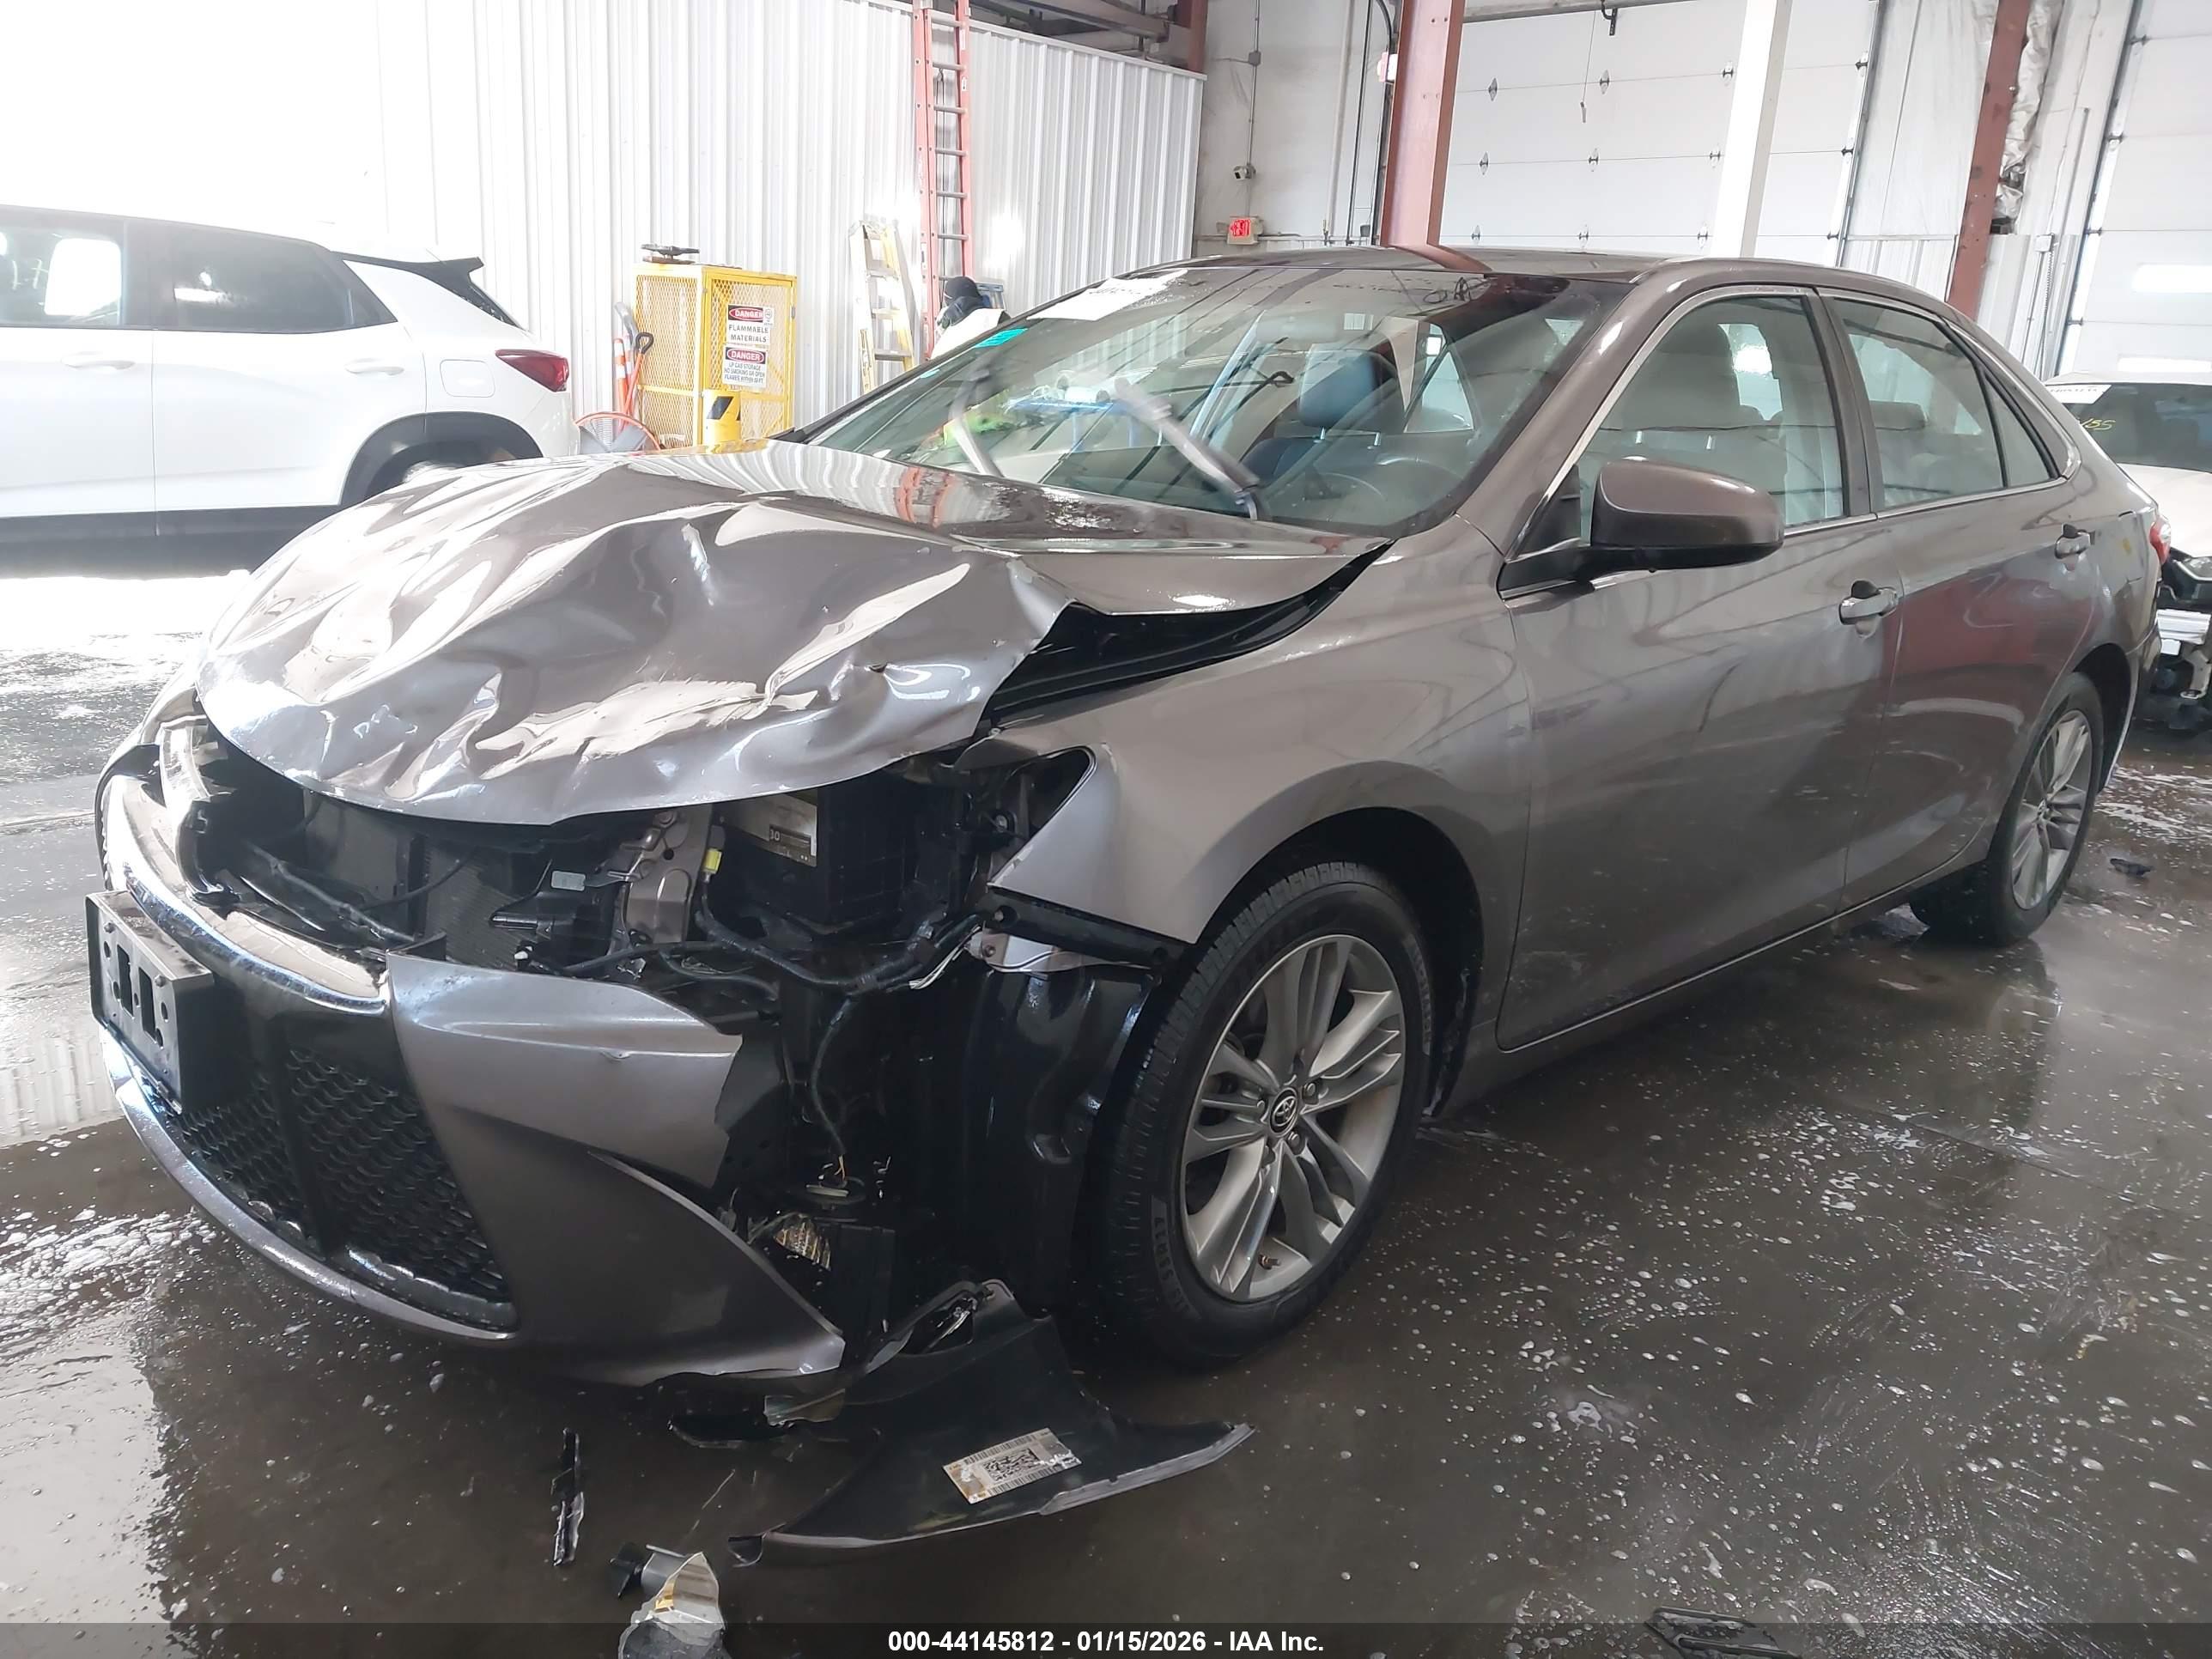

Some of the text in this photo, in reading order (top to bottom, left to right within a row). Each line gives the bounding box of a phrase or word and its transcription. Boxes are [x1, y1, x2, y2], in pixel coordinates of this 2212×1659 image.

[735, 309, 763, 318] DANGER
[729, 324, 769, 333] FLAMMABLE
[730, 334, 767, 343] MATERIALS
[731, 350, 760, 361] DANGER
